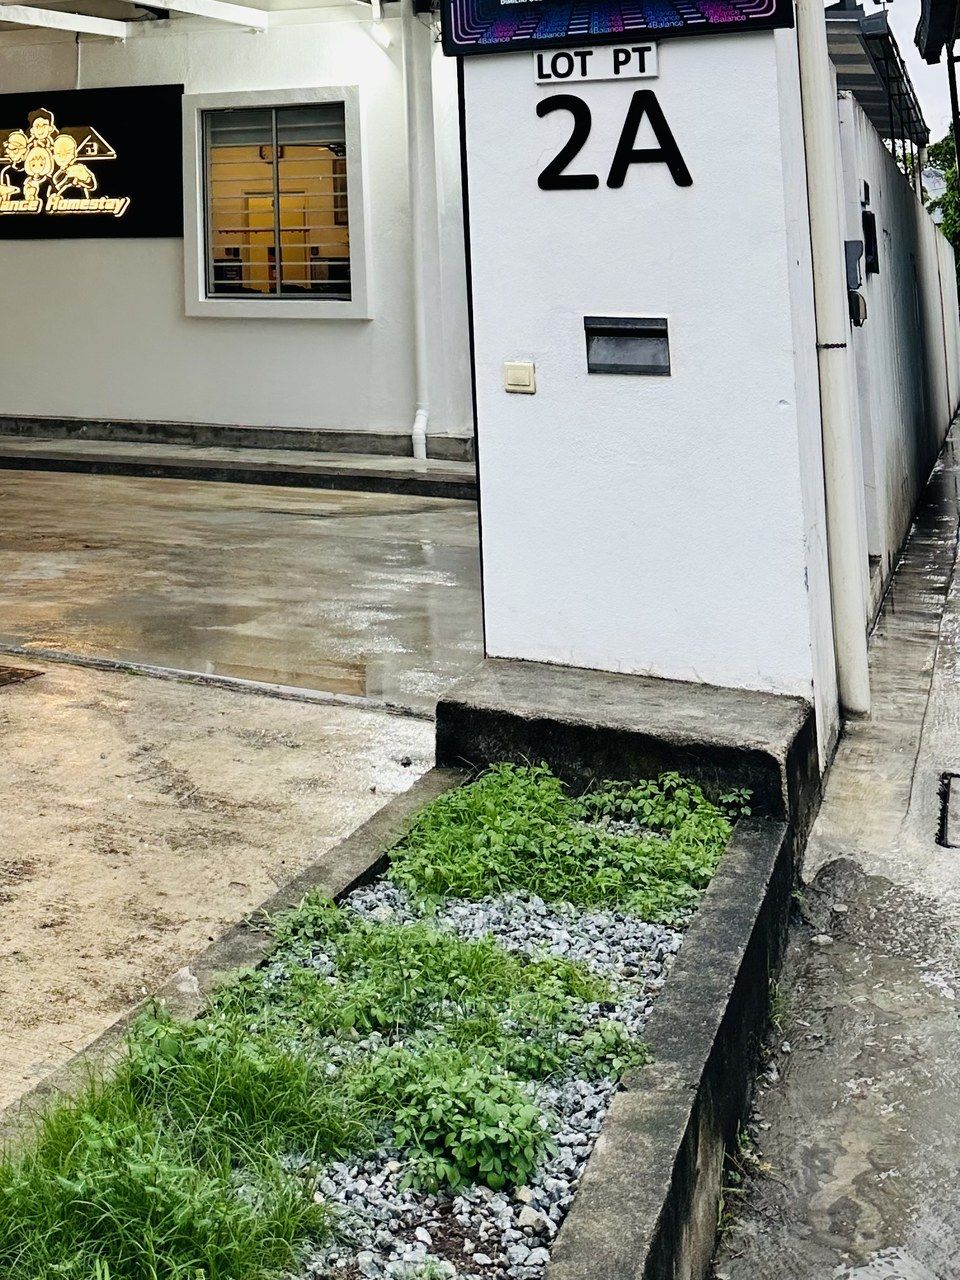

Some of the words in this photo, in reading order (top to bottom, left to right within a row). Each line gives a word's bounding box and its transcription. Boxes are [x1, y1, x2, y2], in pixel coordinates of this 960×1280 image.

[537, 50, 593, 79] LOT
[613, 46, 652, 75] PT
[536, 89, 693, 190] 2A
[45, 195, 130, 217] Homestay
